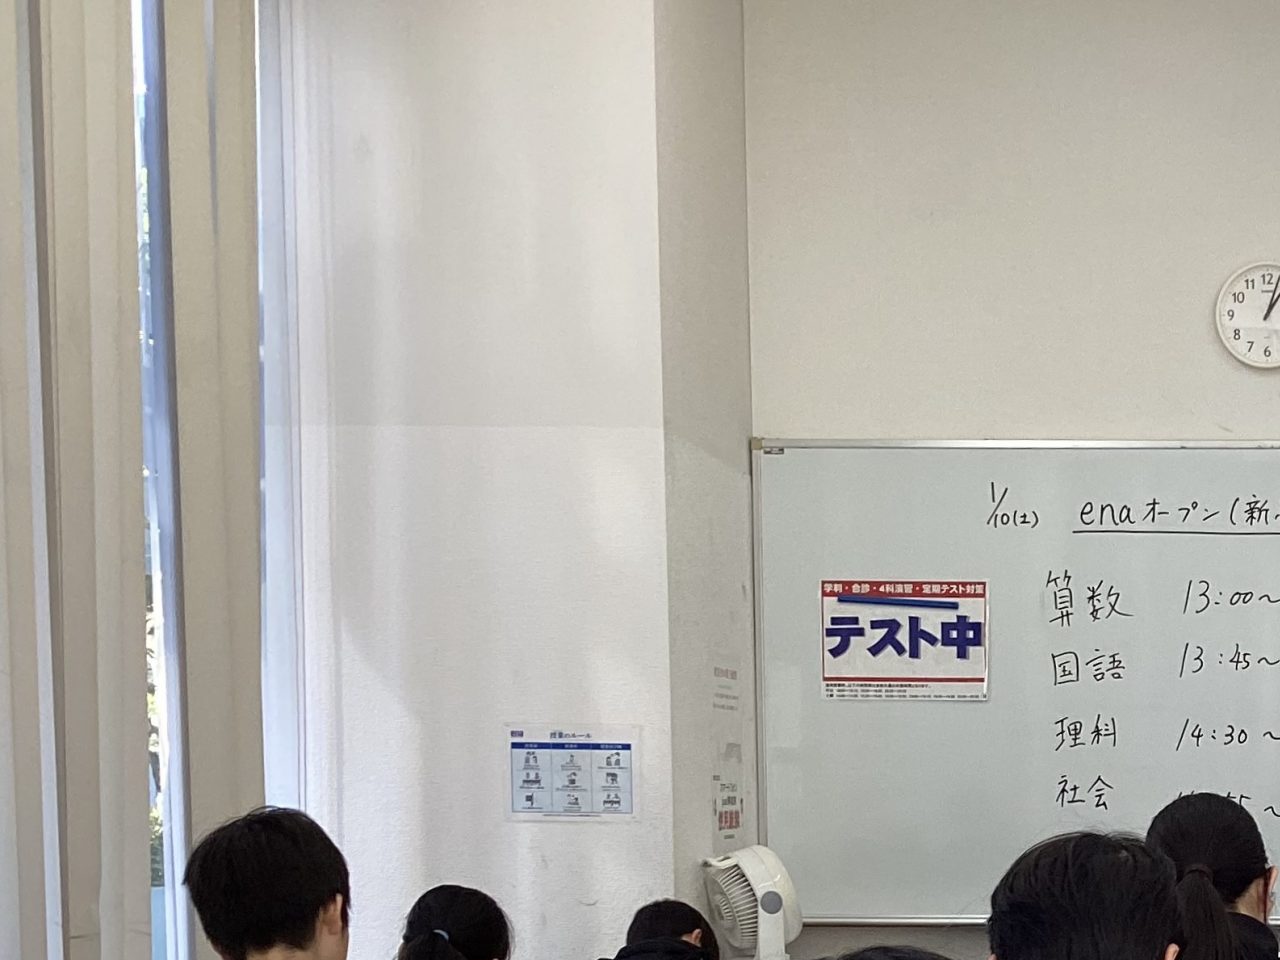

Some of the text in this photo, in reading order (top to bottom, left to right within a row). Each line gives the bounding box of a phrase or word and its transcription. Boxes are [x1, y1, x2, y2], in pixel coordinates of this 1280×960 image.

[1244, 278, 1255, 290] 11
[1261, 273, 1273, 285] 12
[1232, 291, 1245, 304] 10
[1227, 309, 1235, 321] 9
[1233, 328, 1241, 340] 8
[1246, 341, 1255, 353] 7
[1263, 345, 1271, 358] 6
[1046, 569, 1134, 627] 算数
[824, 614, 983, 660] テスト中
[1051, 648, 1126, 687] 国語
[1054, 714, 1118, 751] 理科
[1055, 775, 1114, 810] 社会
